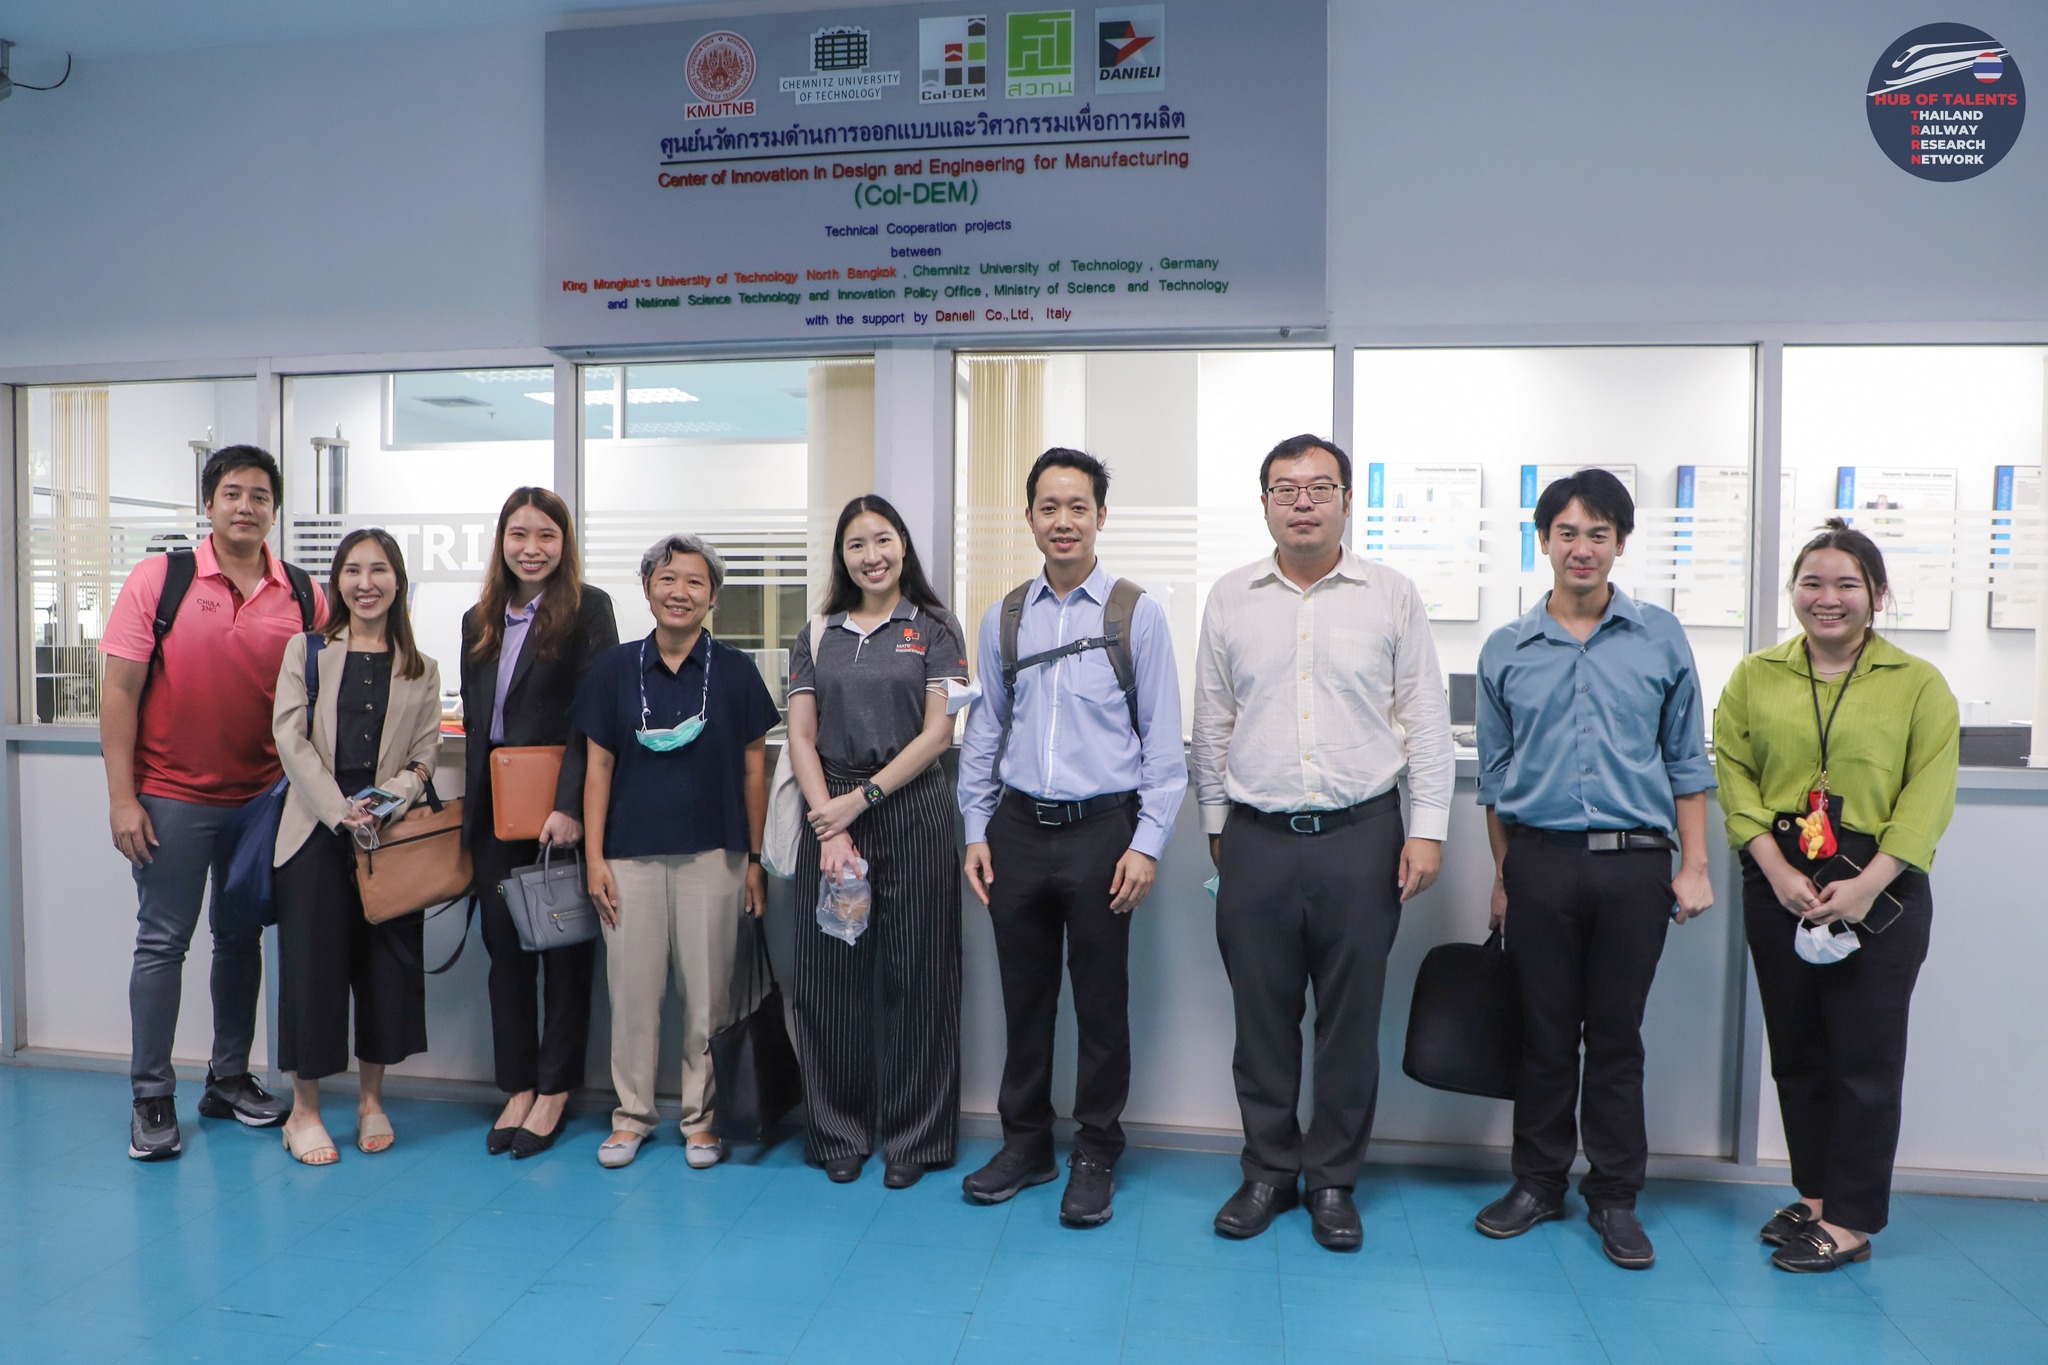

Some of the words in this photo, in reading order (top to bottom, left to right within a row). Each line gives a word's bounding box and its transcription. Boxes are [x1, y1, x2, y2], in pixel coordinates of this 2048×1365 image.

[782, 77, 834, 90] CHEMNITZ
[838, 74, 899, 87] UNIVERSITY
[1099, 66, 1161, 81] DANIELI
[799, 91, 814, 102] OF
[815, 88, 881, 101] TECHNOLOGY
[687, 101, 755, 118] KMUTNB
[660, 103, 1185, 159] ศูนย์นวัตกรรมด้านการออกแบบและวิศวกรรมเพื่อการผลิต
[658, 170, 708, 188] Center
[711, 169, 727, 185] of
[731, 165, 809, 184] Innovation
[814, 165, 827, 179] in
[832, 162, 888, 181] Design
[894, 159, 923, 176] and
[930, 157, 1026, 177] Engineering
[1034, 154, 1058, 169] for
[1065, 150, 1190, 169] Manufacturing
[825, 224, 879, 237] Technical
[886, 221, 957, 236] Cooperation
[965, 219, 1012, 234] projects
[891, 246, 942, 258] between
[562, 280, 588, 294] King
[656, 275, 712, 289] University
[716, 273, 729, 285] of
[734, 271, 798, 286] Technology
[806, 268, 840, 281] North
[912, 264, 971, 277] Chemnitz
[979, 261, 1039, 276] University
[1048, 260, 1061, 272] of
[1160, 257, 1220, 272] Germany
[607, 298, 628, 310] and
[635, 295, 681, 309] National
[688, 293, 732, 306] Science
[738, 290, 802, 306] Technology
[808, 289, 830, 302] and
[837, 287, 896, 301] Innovation
[904, 286, 939, 302] Policy
[994, 284, 1041, 299] Ministry
[1047, 282, 1060, 295] of
[1067, 281, 1116, 294] Science
[1127, 280, 1149, 293] and
[1159, 279, 1230, 294] Technology
[805, 314, 829, 326] with
[836, 313, 855, 325] the
[862, 312, 905, 327] support
[914, 311, 928, 325] by
[935, 309, 976, 322] Danieli
[1046, 307, 1072, 322] Italy
[360, 524, 486, 571] TRI
[196, 598, 221, 608] CHULA
